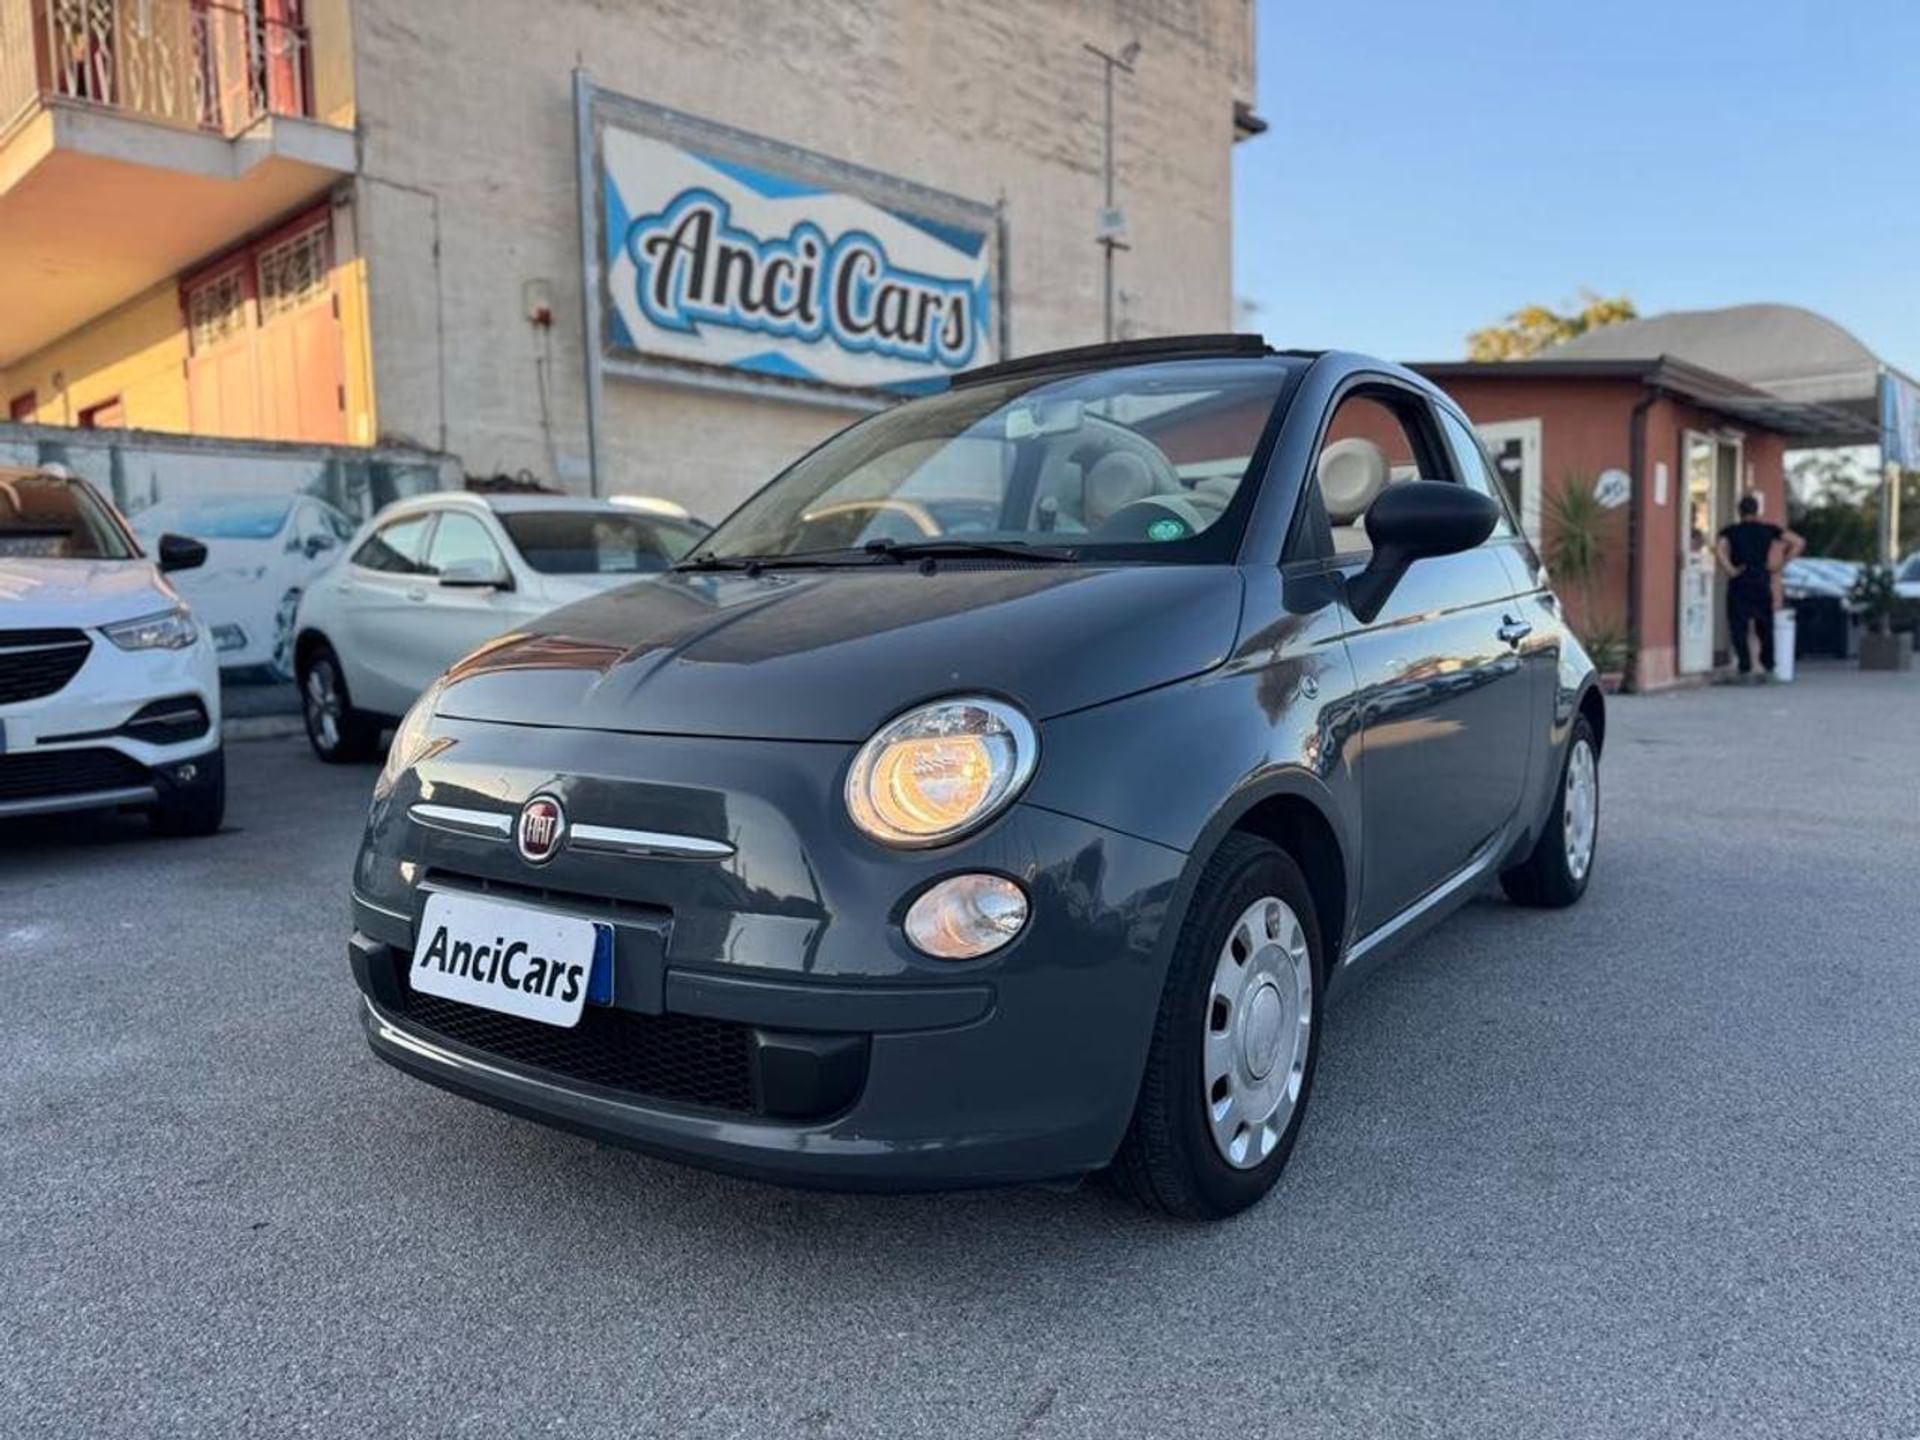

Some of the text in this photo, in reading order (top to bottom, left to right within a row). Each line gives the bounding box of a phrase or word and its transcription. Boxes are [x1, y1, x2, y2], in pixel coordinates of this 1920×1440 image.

[646, 209, 966, 352] Anci Cars
[525, 813, 556, 845] FIAT
[419, 925, 584, 1003] AnciCars
